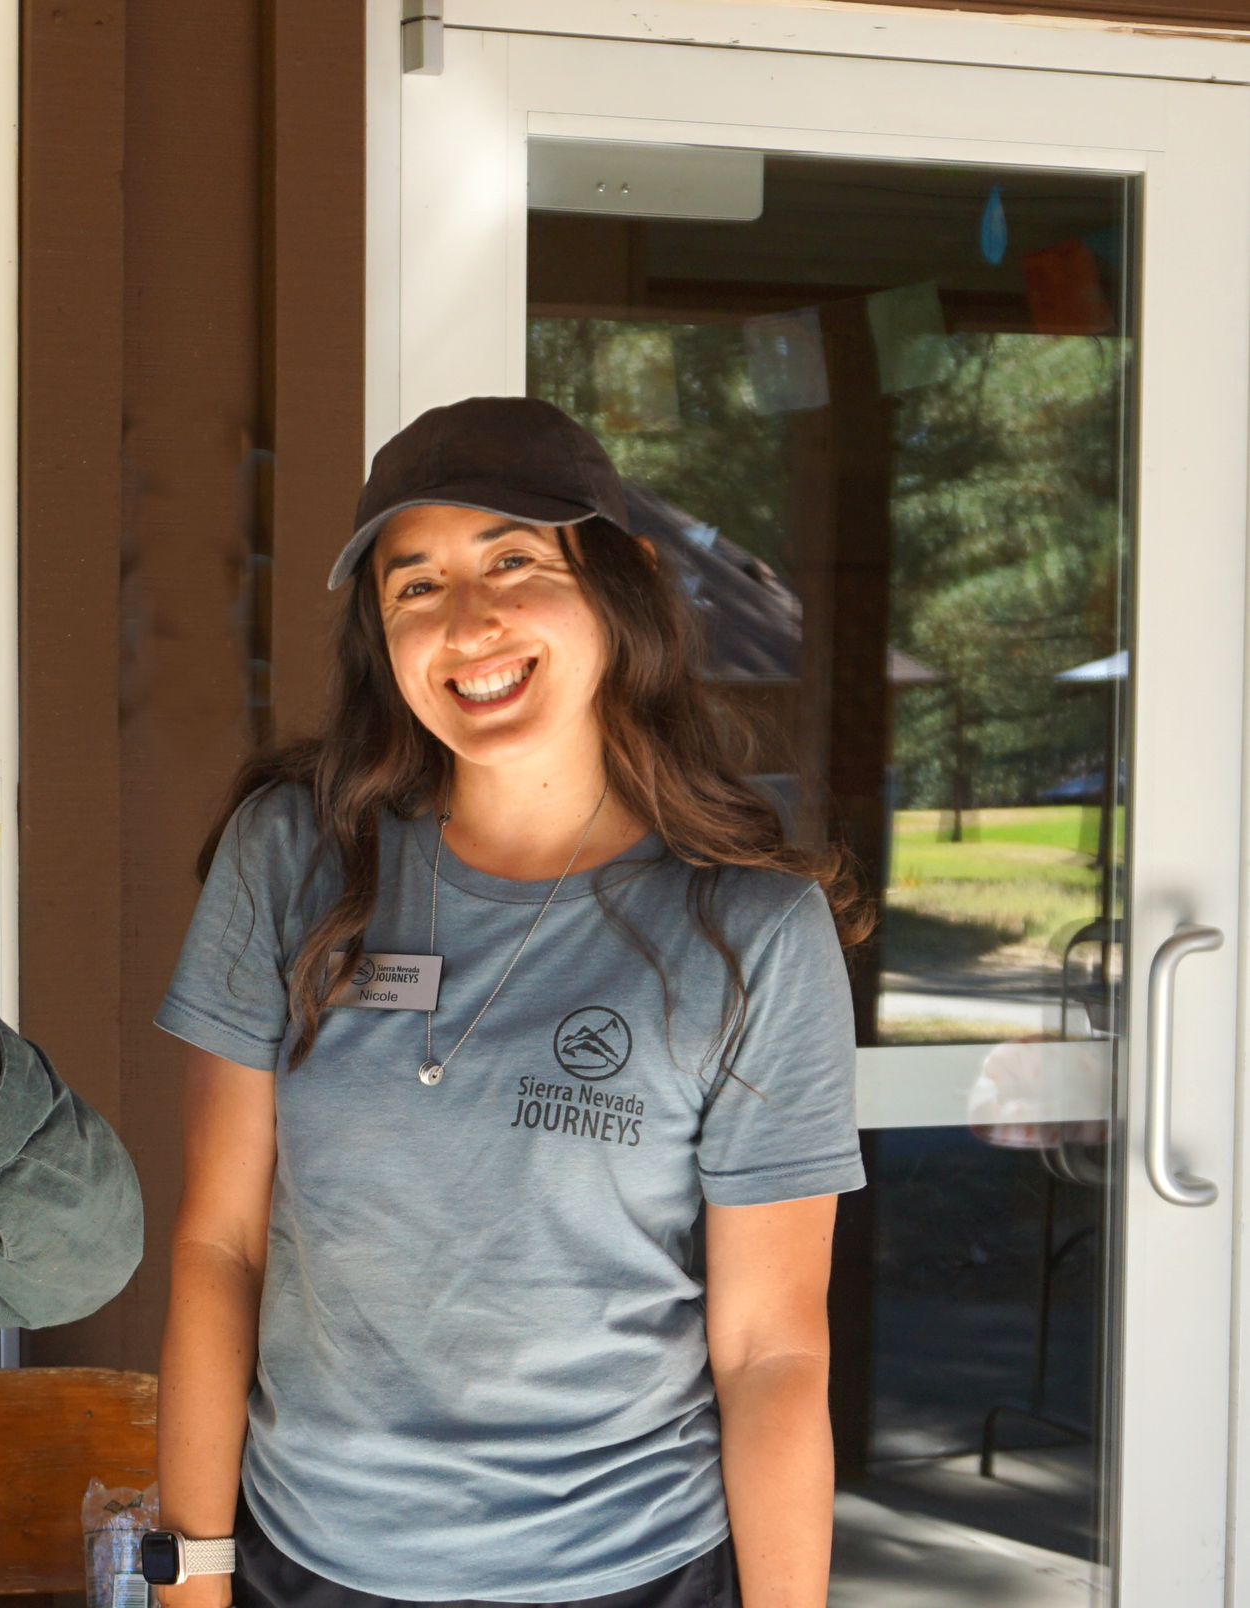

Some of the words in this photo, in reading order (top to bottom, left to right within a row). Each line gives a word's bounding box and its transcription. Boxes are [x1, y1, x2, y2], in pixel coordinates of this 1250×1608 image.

[377, 964, 395, 972] Sierra
[397, 965, 420, 973] Nevada
[375, 972, 419, 983] JOURNEYS
[359, 989, 399, 1002] Nicole
[517, 1075, 573, 1102] Sierra
[578, 1083, 645, 1116] Nevada
[511, 1099, 643, 1147] JOURNEYS
